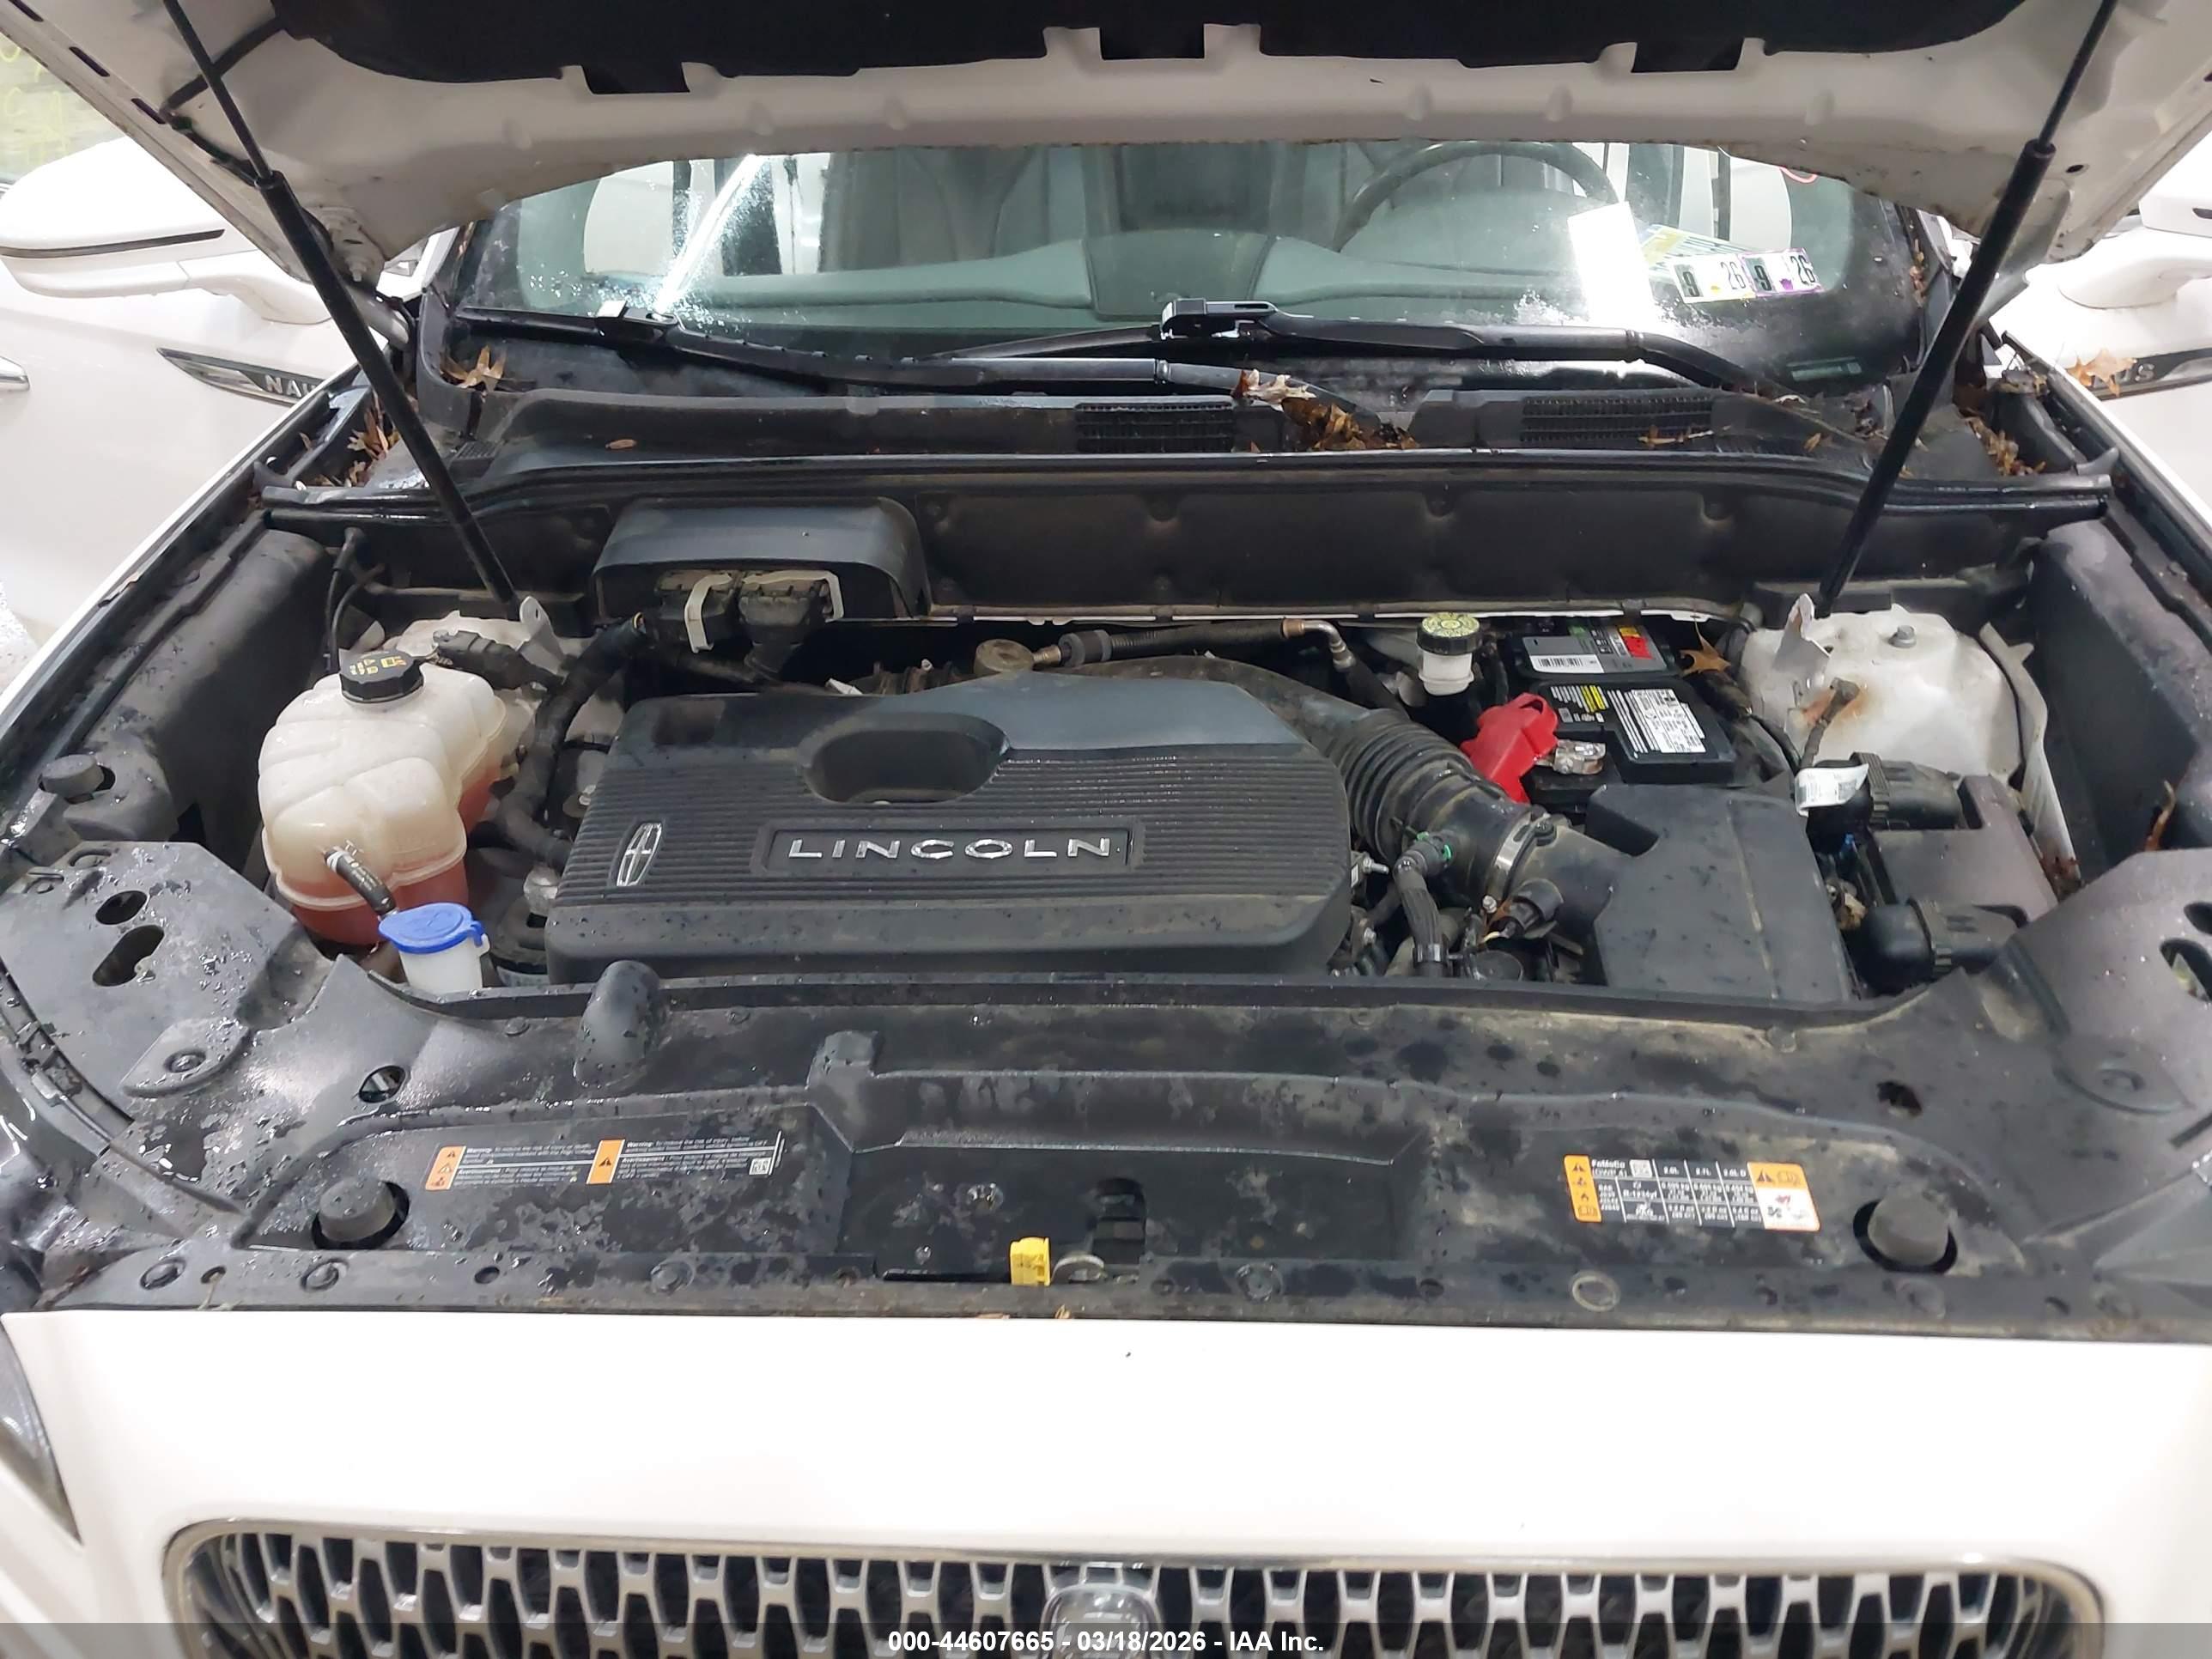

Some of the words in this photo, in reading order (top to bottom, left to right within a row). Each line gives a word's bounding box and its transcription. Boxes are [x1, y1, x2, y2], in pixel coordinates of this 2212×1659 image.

[1683, 271, 1700, 297] 9
[1720, 261, 1747, 290] 26
[1754, 265, 1772, 291] 9
[1790, 255, 1816, 284] 26
[788, 837, 1110, 859] LINCOLN
